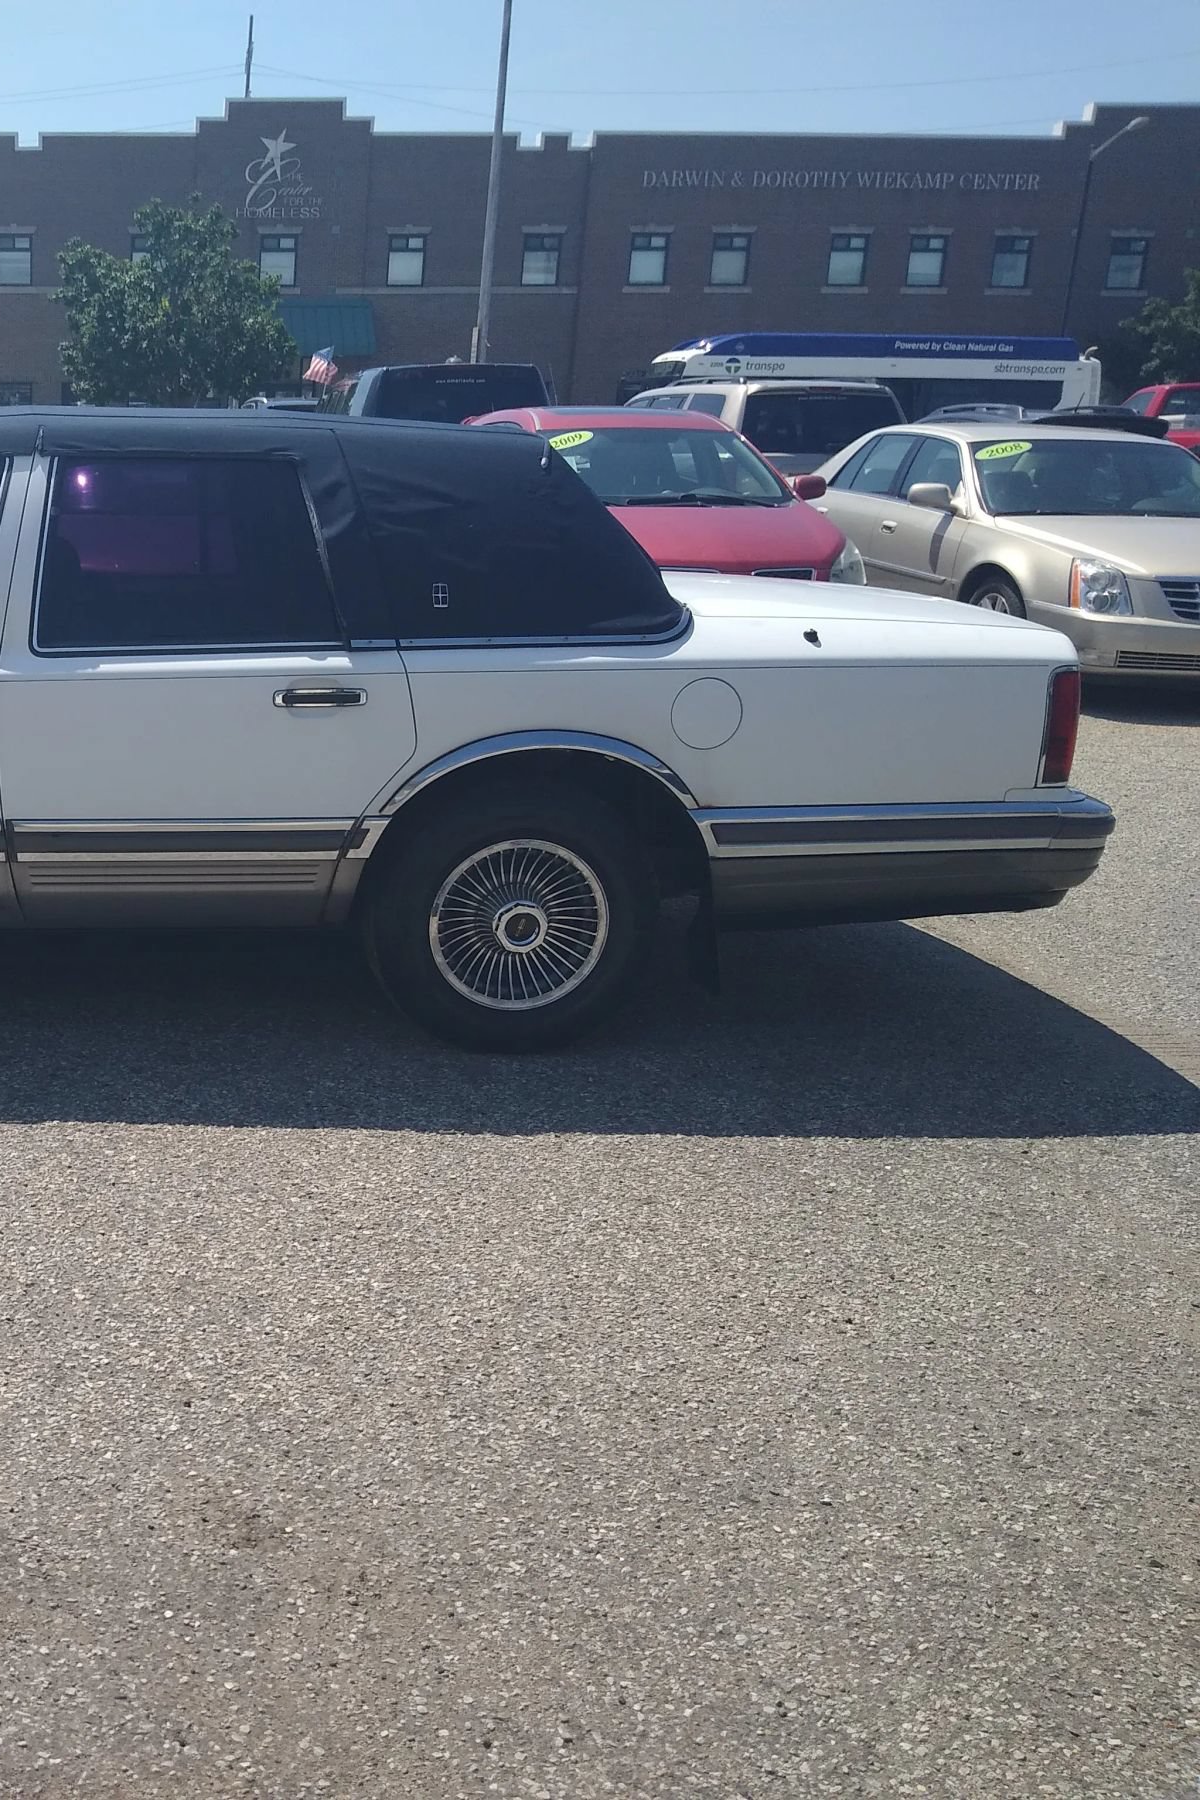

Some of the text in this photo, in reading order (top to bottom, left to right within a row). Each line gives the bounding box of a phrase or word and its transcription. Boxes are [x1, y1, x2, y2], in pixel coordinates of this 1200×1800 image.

[643, 170, 1041, 190] DARWIN & DOROTHY WIEKAMP CENTER
[235, 207, 320, 218] HOMELESS
[895, 341, 1014, 352] Powered by Clean Natural Gas
[746, 361, 785, 373] transpo
[552, 433, 582, 448] 2009
[985, 443, 1022, 457] 2008
